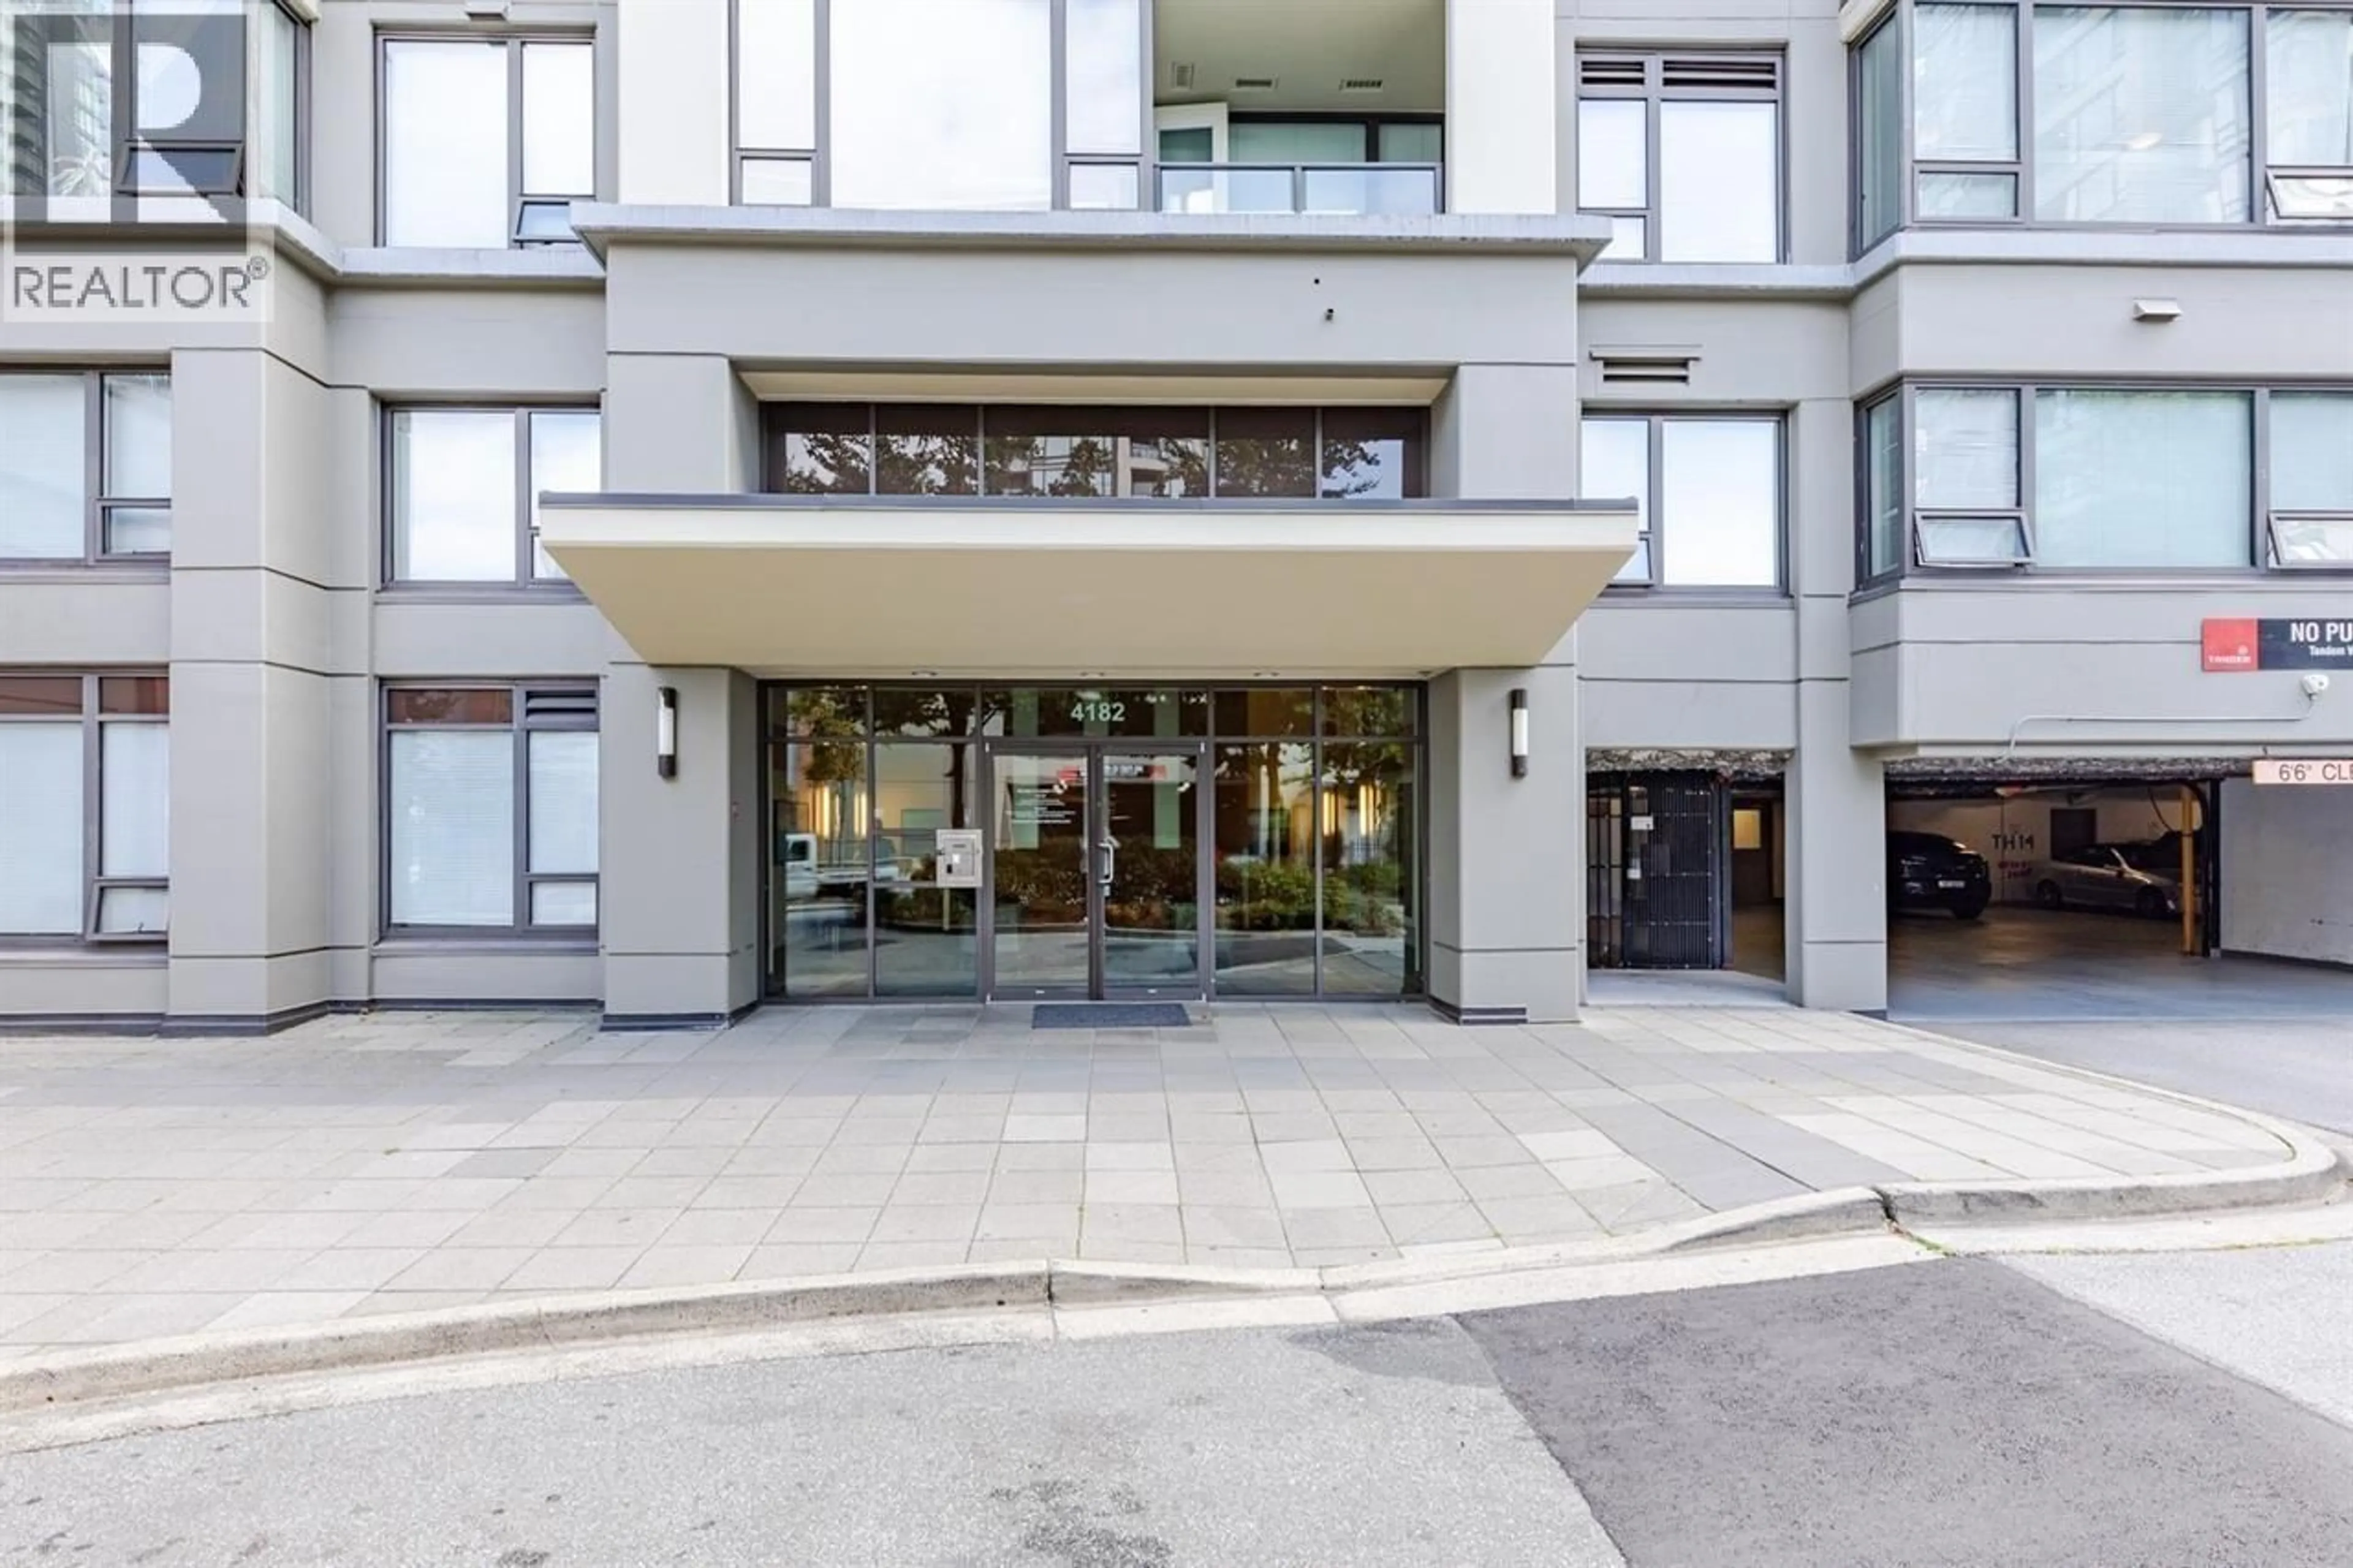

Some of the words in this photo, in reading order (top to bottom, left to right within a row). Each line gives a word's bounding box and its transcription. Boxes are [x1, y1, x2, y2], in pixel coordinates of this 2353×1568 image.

[2290, 622, 2319, 642] NO
[2326, 622, 2352, 642] PU
[1070, 702, 1126, 721] 4182
